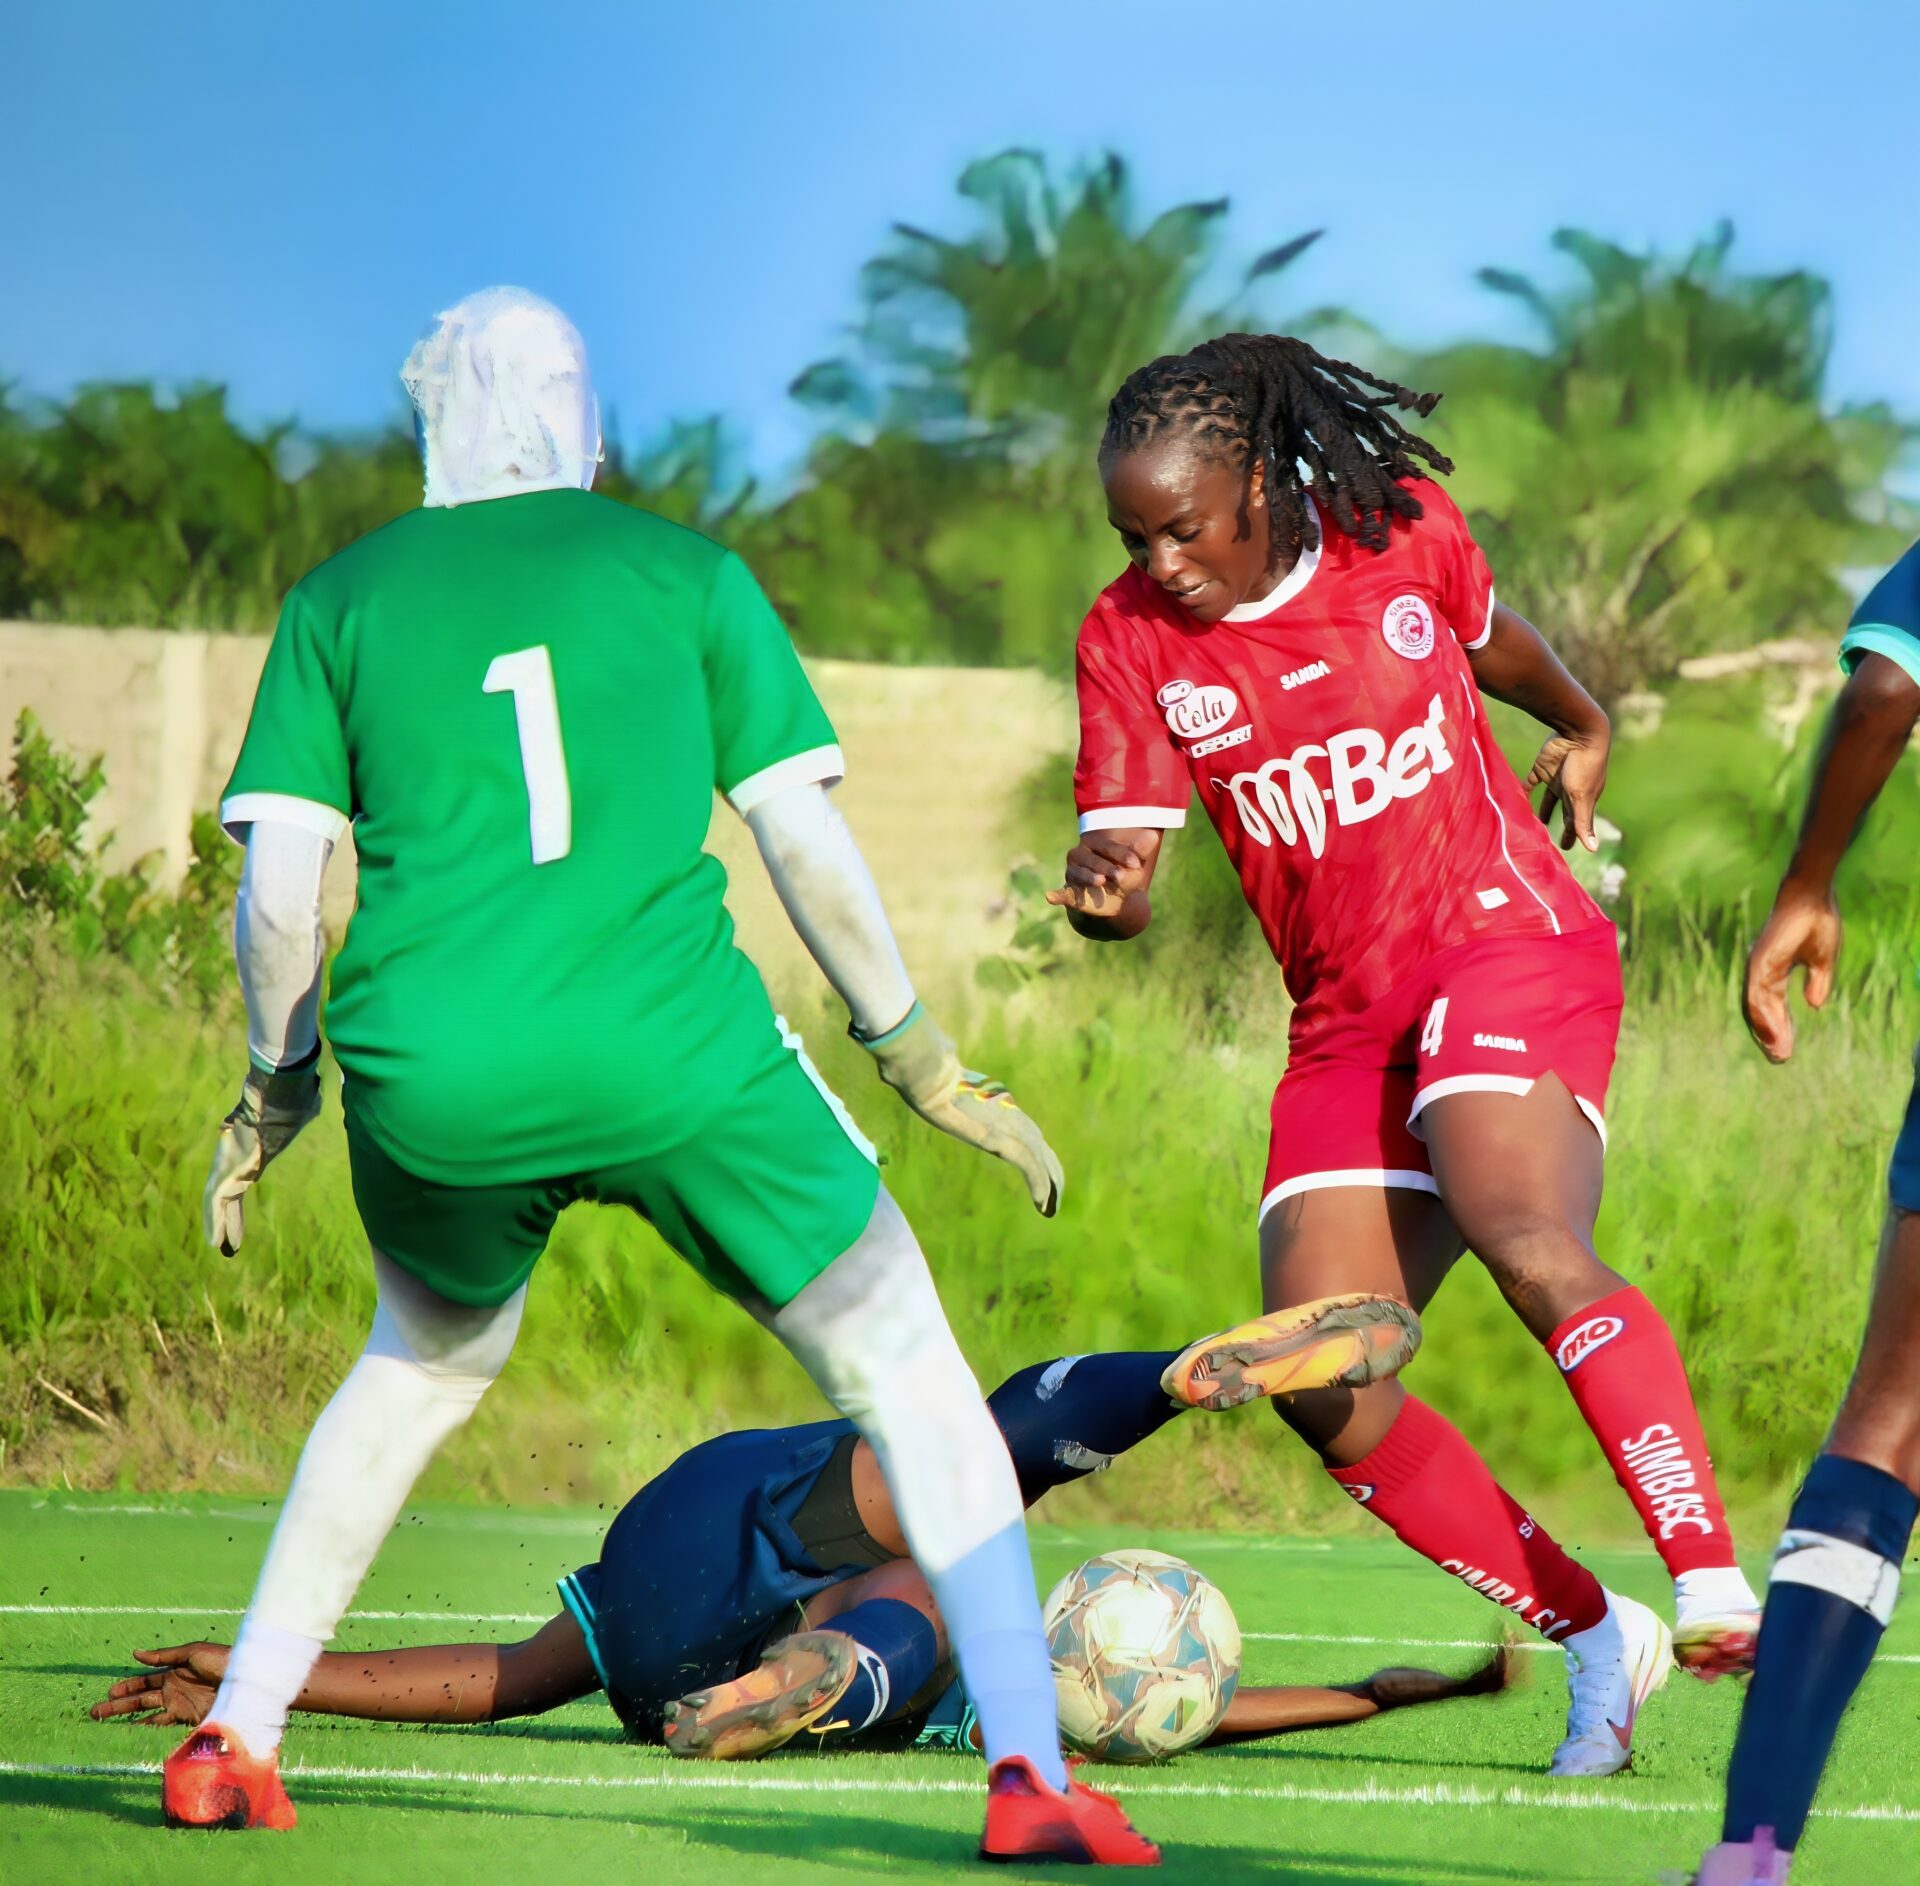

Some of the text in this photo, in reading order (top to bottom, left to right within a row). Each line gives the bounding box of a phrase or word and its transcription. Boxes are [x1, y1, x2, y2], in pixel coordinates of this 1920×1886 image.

[1279, 659, 1332, 691] SANDA
[1174, 695, 1226, 734] Cola
[482, 645, 572, 865] 1
[1420, 996, 1449, 1057] 4
[1473, 1033, 1527, 1053] SANDA
